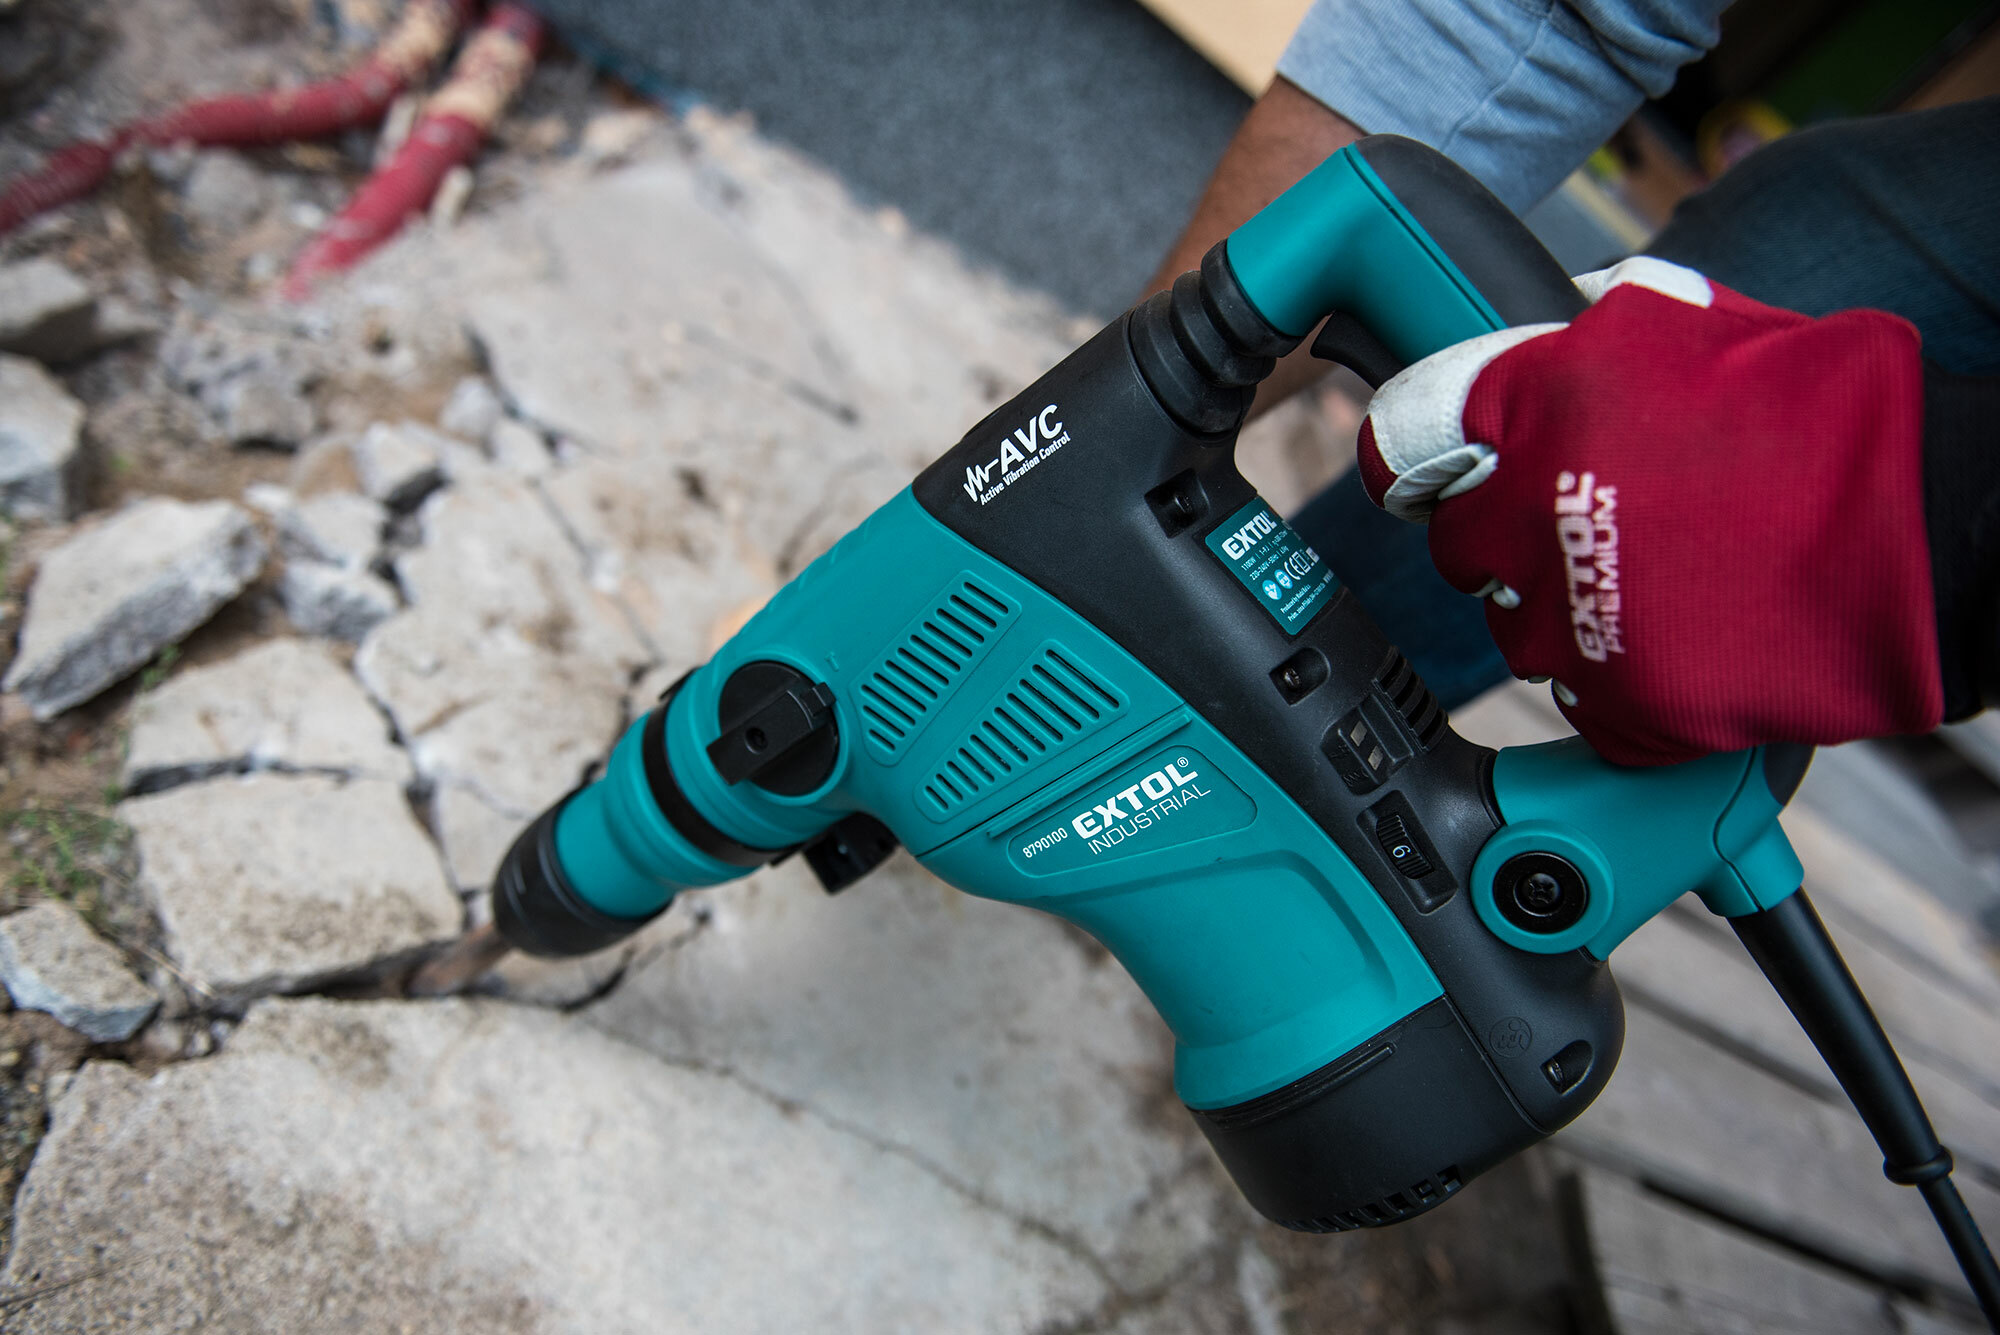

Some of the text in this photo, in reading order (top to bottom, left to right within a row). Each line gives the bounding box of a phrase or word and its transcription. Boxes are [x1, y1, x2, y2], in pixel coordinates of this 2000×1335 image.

[980, 430, 1071, 506] Active Vibration Control
[1592, 485, 1626, 655] PREMIUM
[1022, 827, 1068, 859] 8790100
[1087, 784, 1211, 855] INDUSTRIAL
